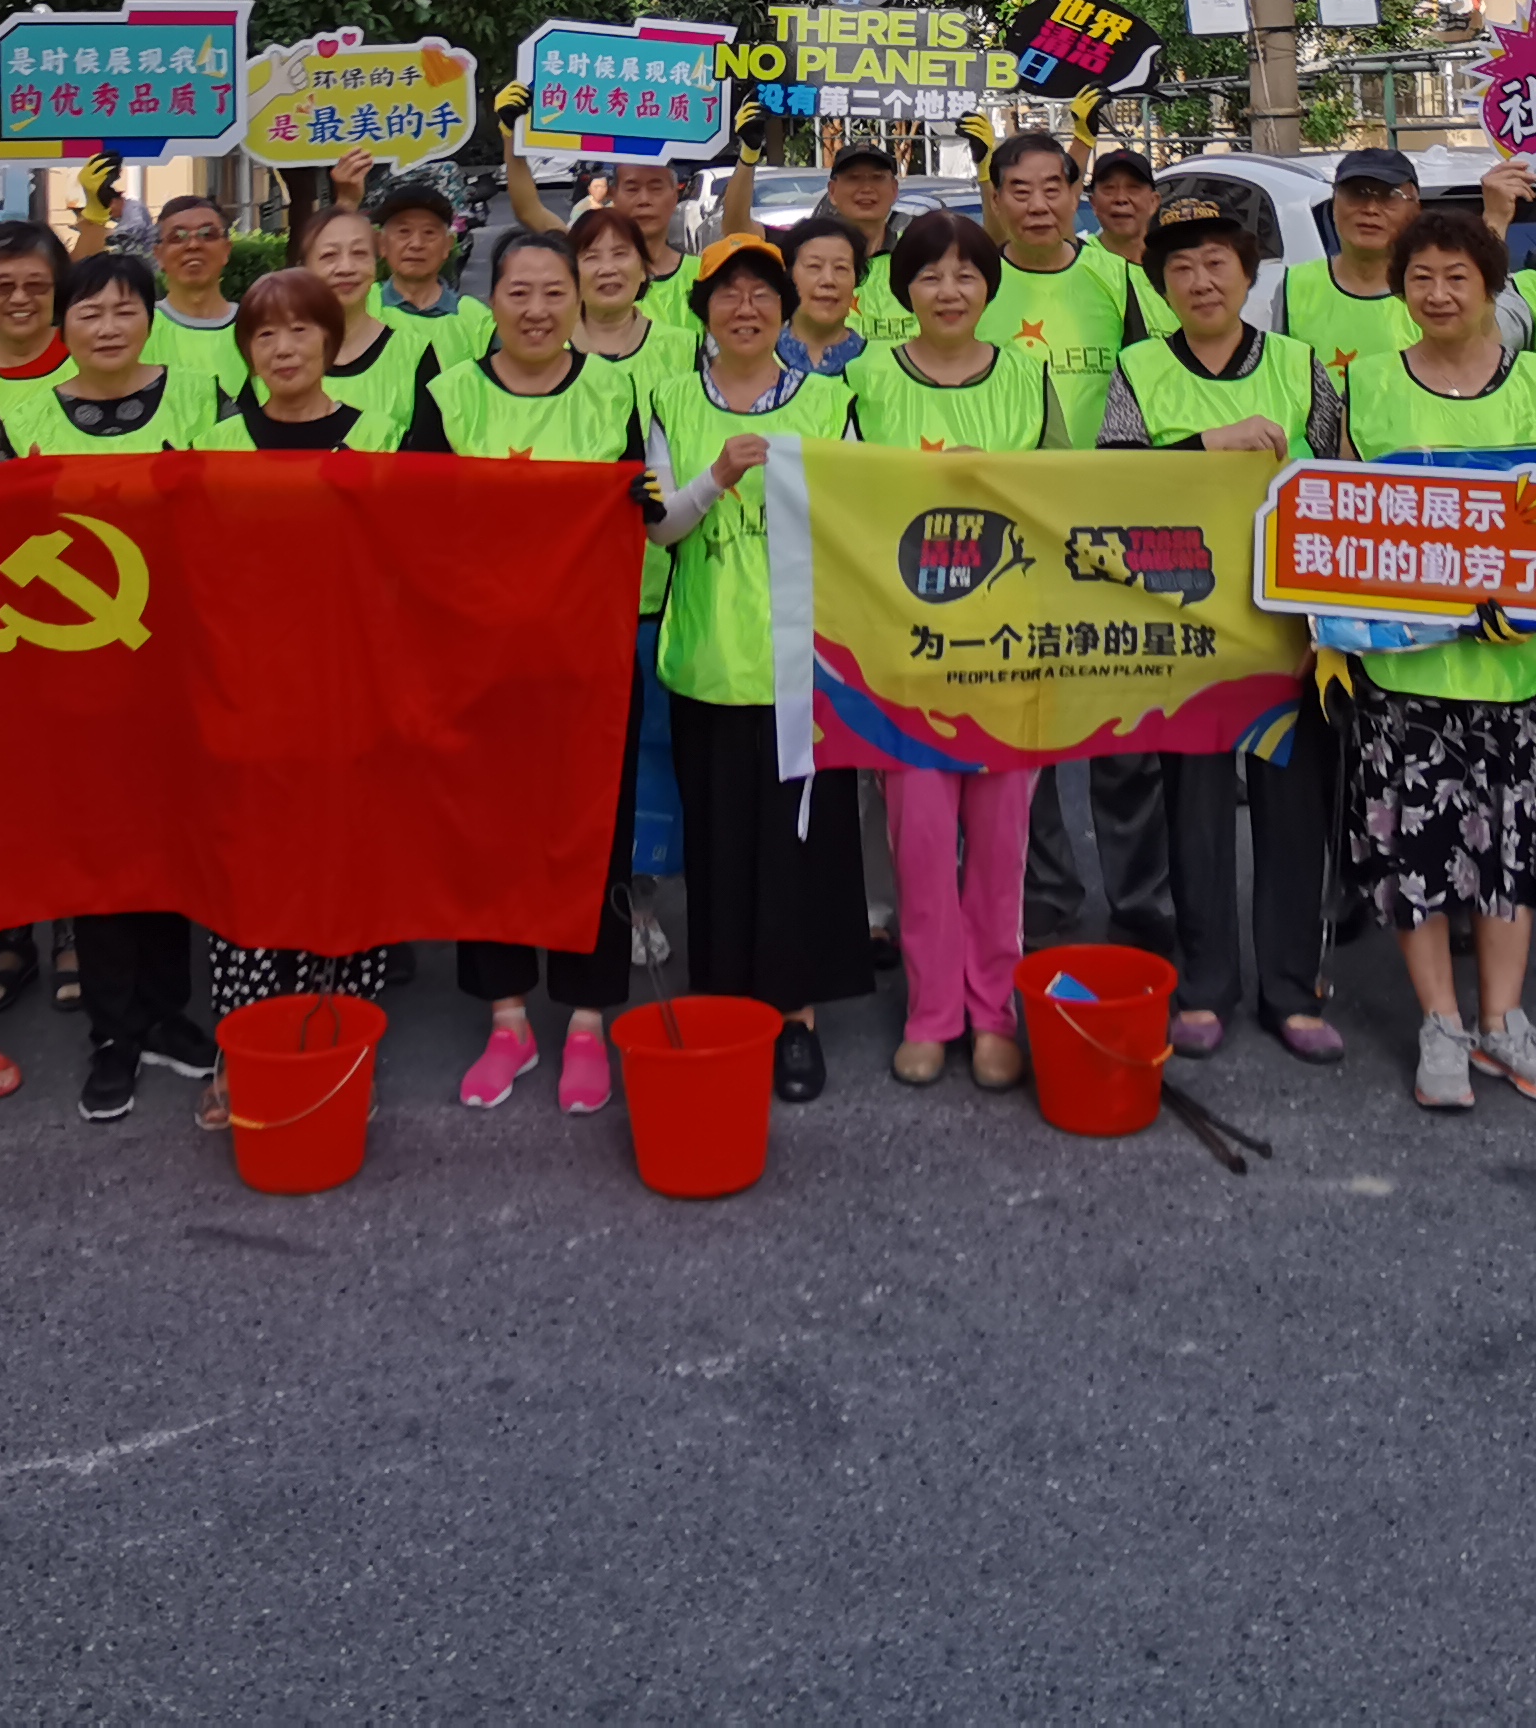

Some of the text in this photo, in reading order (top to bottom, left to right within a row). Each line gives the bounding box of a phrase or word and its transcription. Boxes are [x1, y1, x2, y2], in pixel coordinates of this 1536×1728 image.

[768, 6, 968, 49] THERE IS
[1029, 19, 1116, 74] 清洁
[7, 45, 229, 76] 是时候展现我们
[312, 65, 424, 90] 环保的手
[541, 50, 716, 88] 是时候展现我们
[714, 43, 1020, 89] NO PLANET B
[1016, 47, 1060, 85] 日
[9, 81, 233, 117] 的优秀品质了
[540, 82, 718, 123] 的优秀品质了
[757, 82, 977, 120] 没有第二个地球
[267, 101, 463, 145] 是最美的手
[1295, 478, 1506, 533] 是时候展示
[910, 620, 1217, 661] 为一个洁净的星球
[1113, 663, 1175, 678] PLANET
